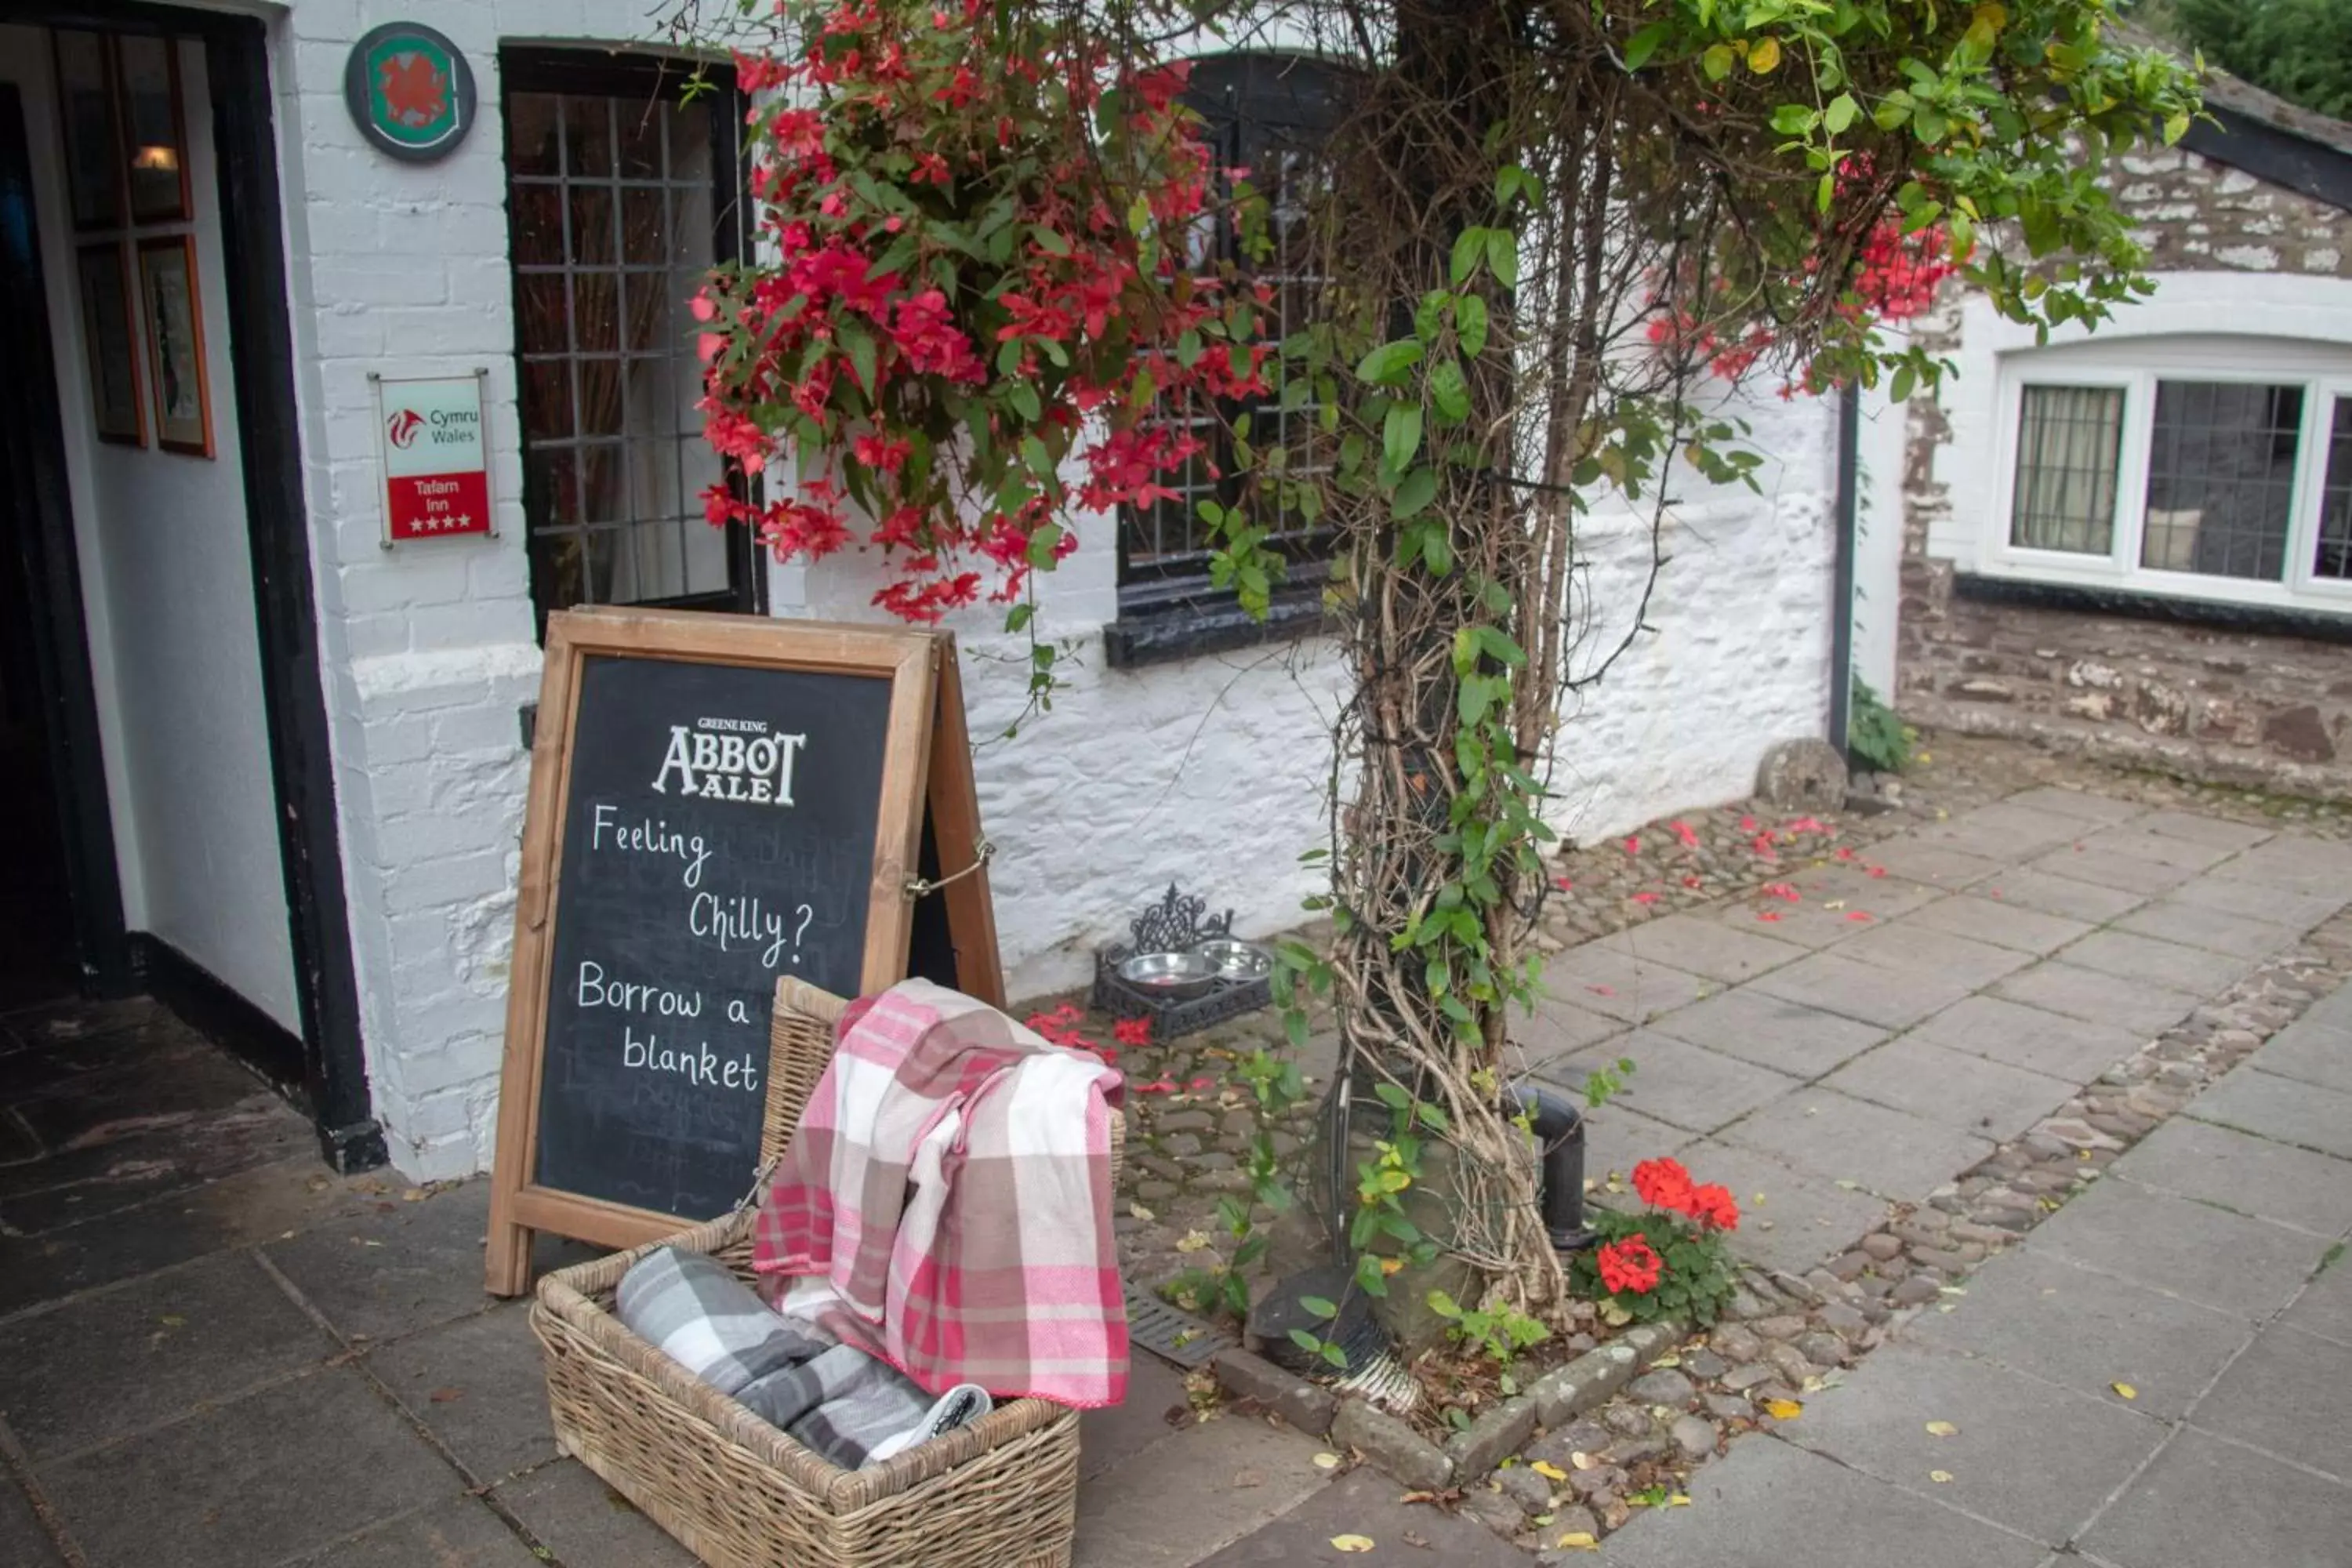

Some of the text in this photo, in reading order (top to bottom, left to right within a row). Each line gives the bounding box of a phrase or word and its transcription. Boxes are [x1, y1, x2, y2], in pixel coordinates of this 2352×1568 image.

[430, 410, 479, 427] Cymru
[432, 430, 475, 444] Wales
[426, 498, 449, 512] Inn
[698, 717, 768, 733] GREENE KING
[652, 725, 807, 807] ABBOT
[699, 774, 772, 804] ALE
[593, 805, 712, 888] Feeling
[690, 892, 814, 968] Chilly?
[579, 961, 749, 1022] Borrow a
[624, 1027, 758, 1091] blanket
